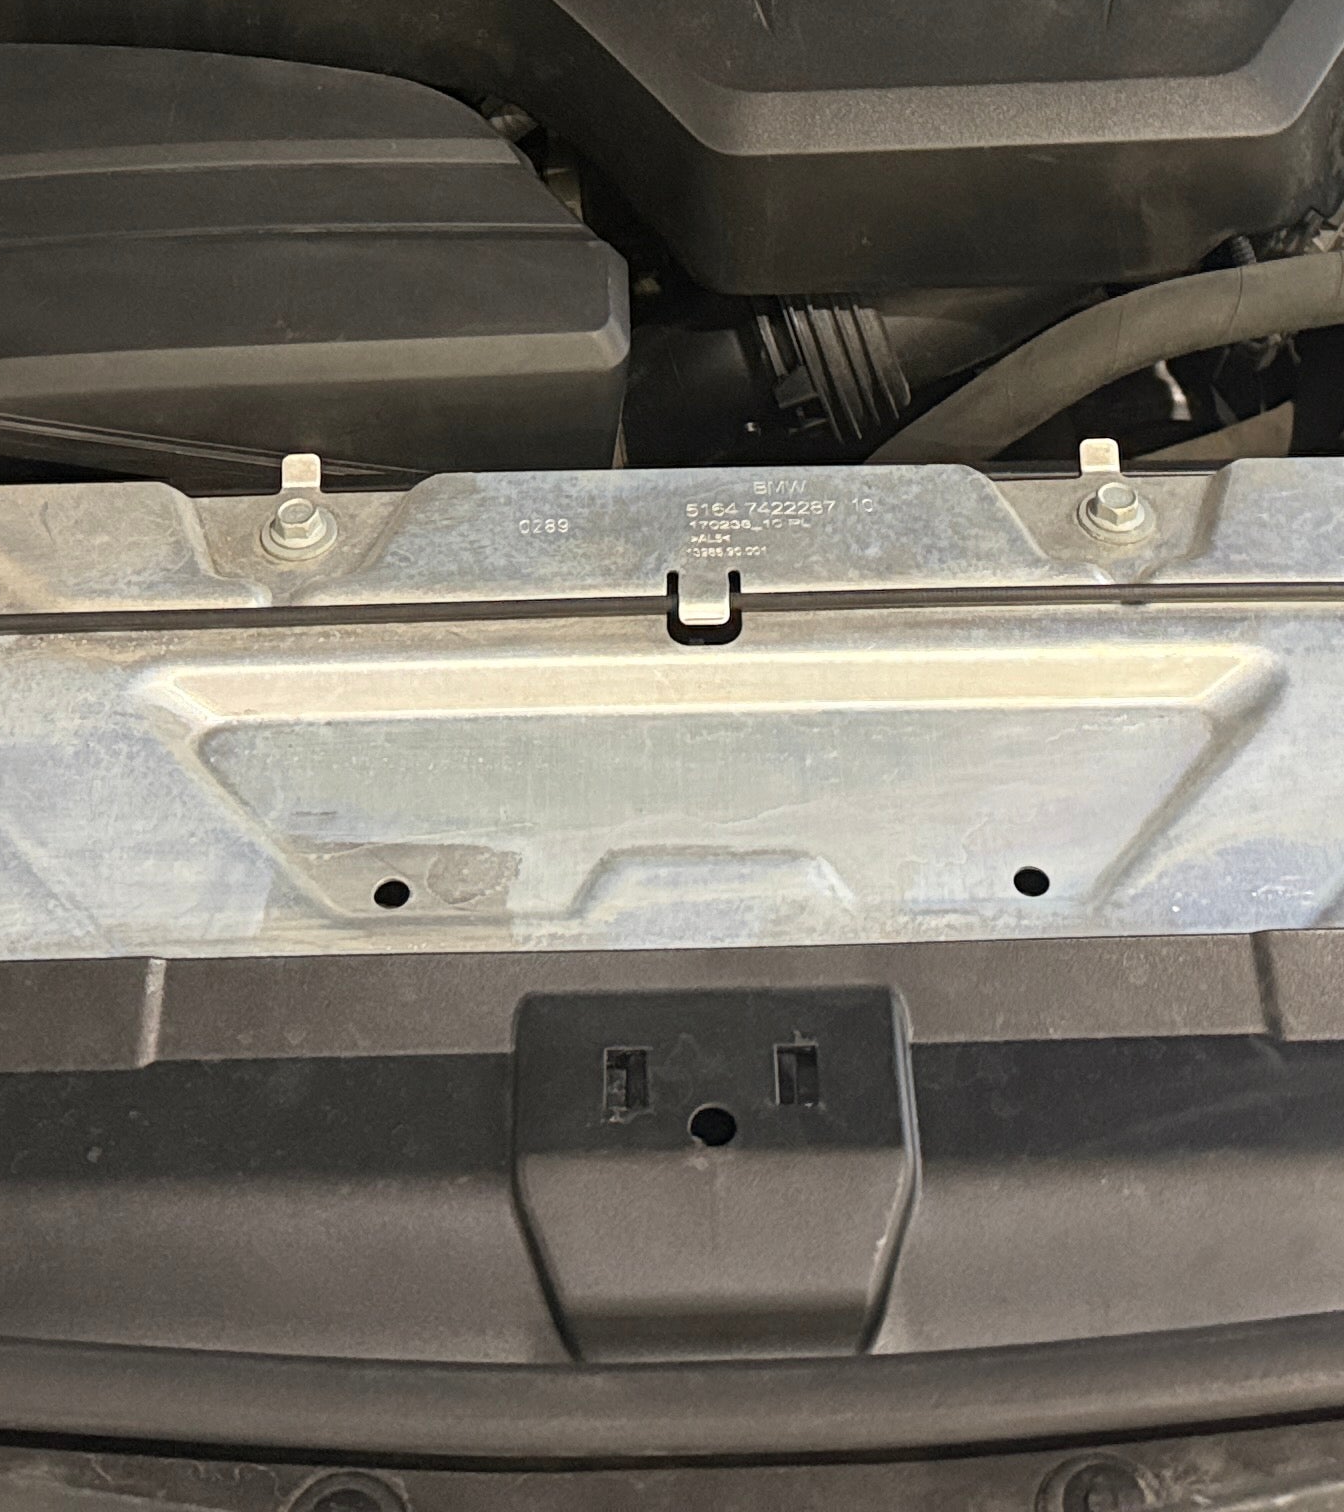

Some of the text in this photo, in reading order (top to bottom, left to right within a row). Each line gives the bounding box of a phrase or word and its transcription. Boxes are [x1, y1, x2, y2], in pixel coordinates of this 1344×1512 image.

[753, 479, 807, 496] BMW
[685, 497, 874, 518] 5164 7422287 10
[518, 517, 569, 534] 0289
